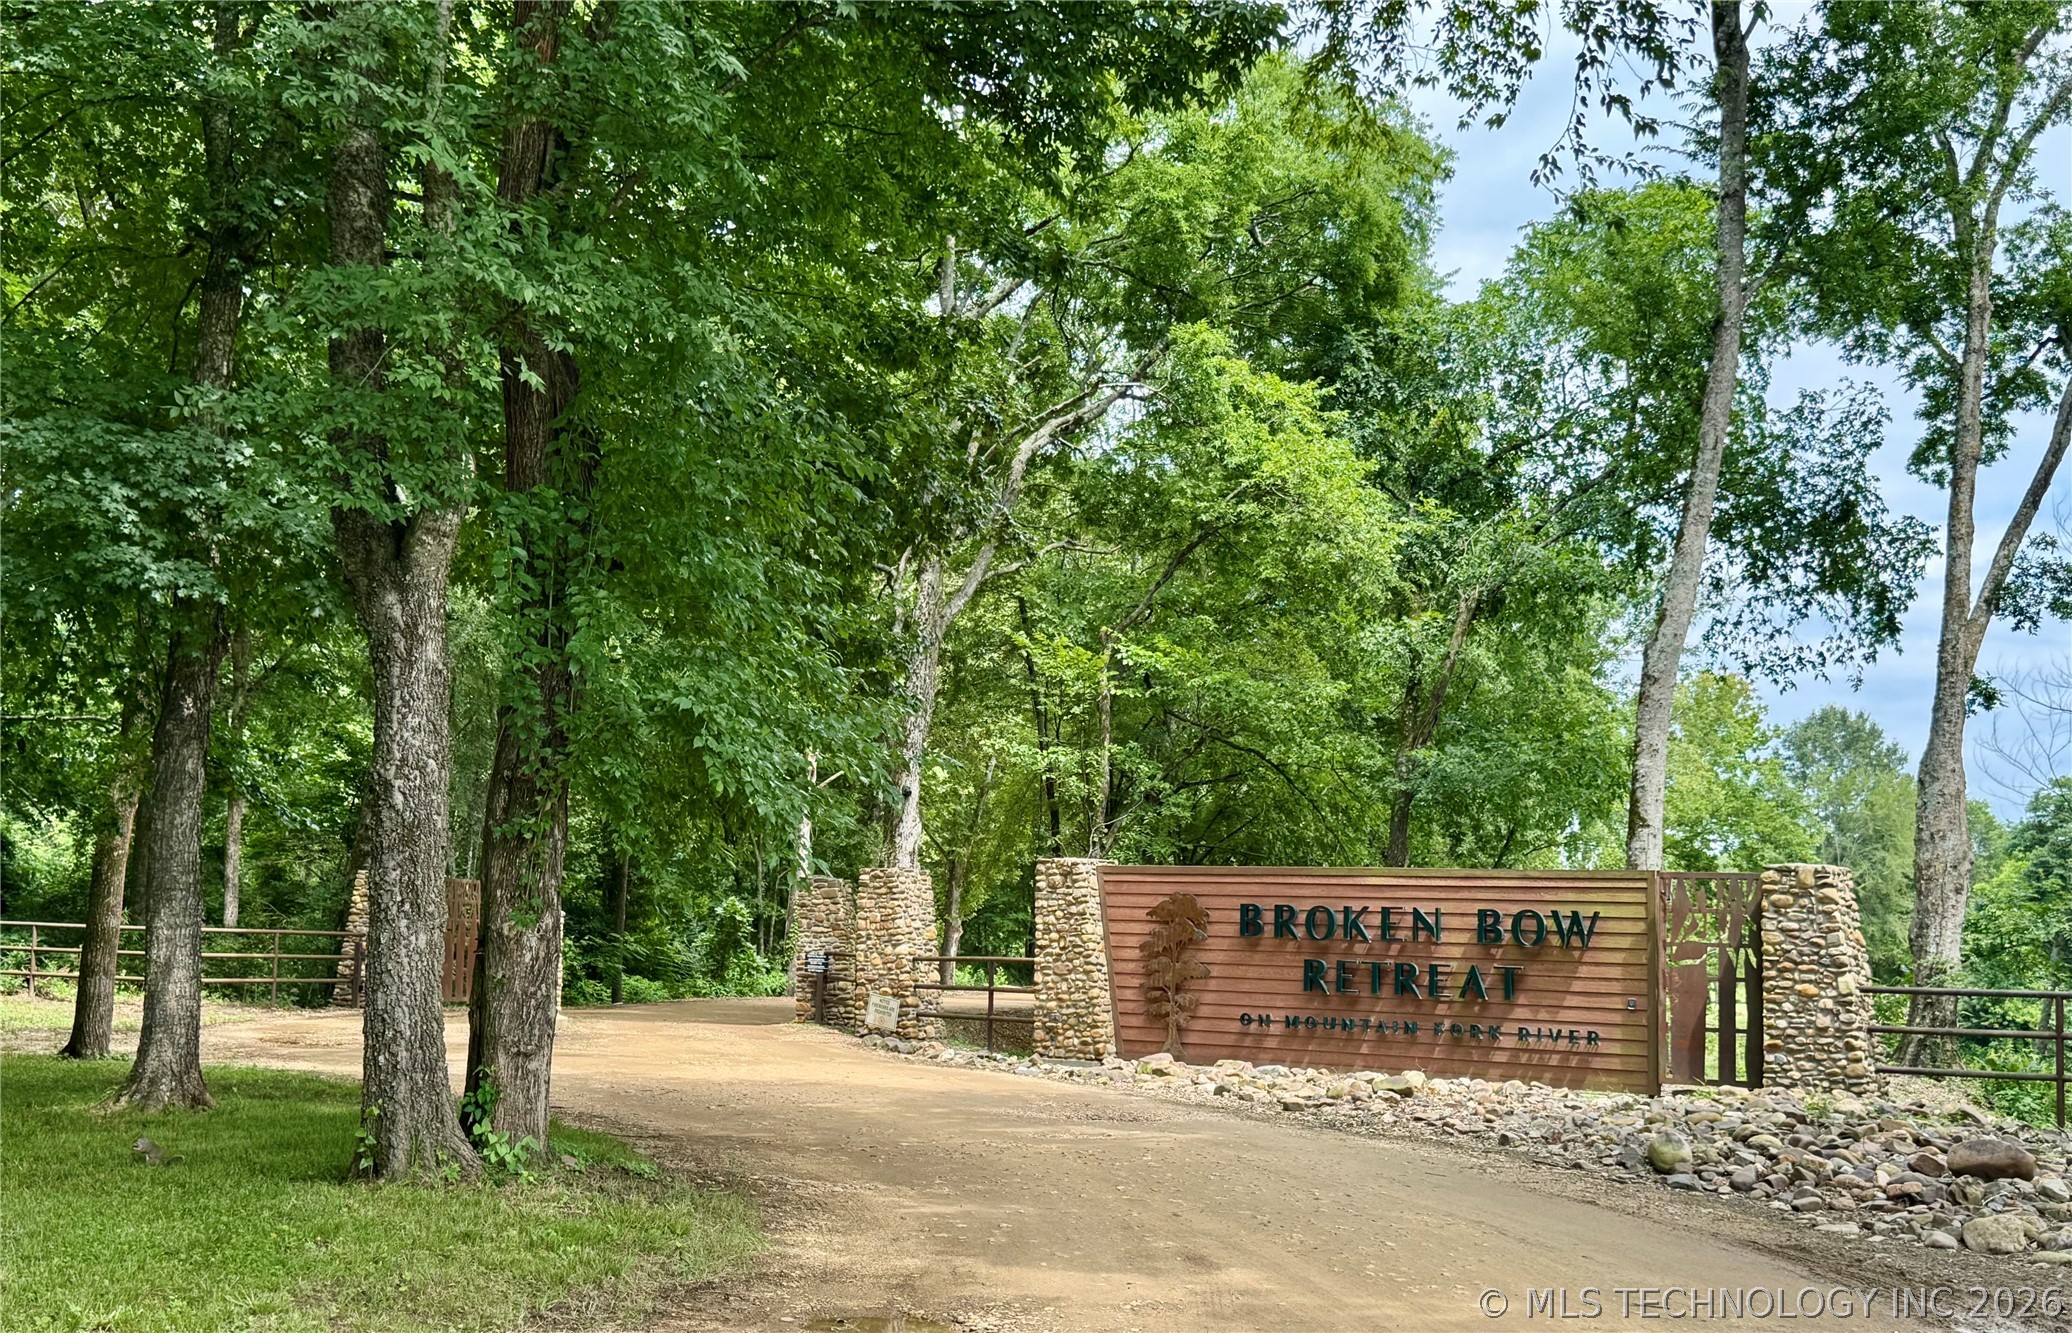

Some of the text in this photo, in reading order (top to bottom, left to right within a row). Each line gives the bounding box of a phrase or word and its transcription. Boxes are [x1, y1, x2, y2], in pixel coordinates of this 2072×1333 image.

[1239, 903, 1600, 949] BROKEN BOW
[1304, 959, 1524, 1001] RETREAT
[1240, 1012, 1600, 1046] ON MOUNTAIN FORK RIVER
